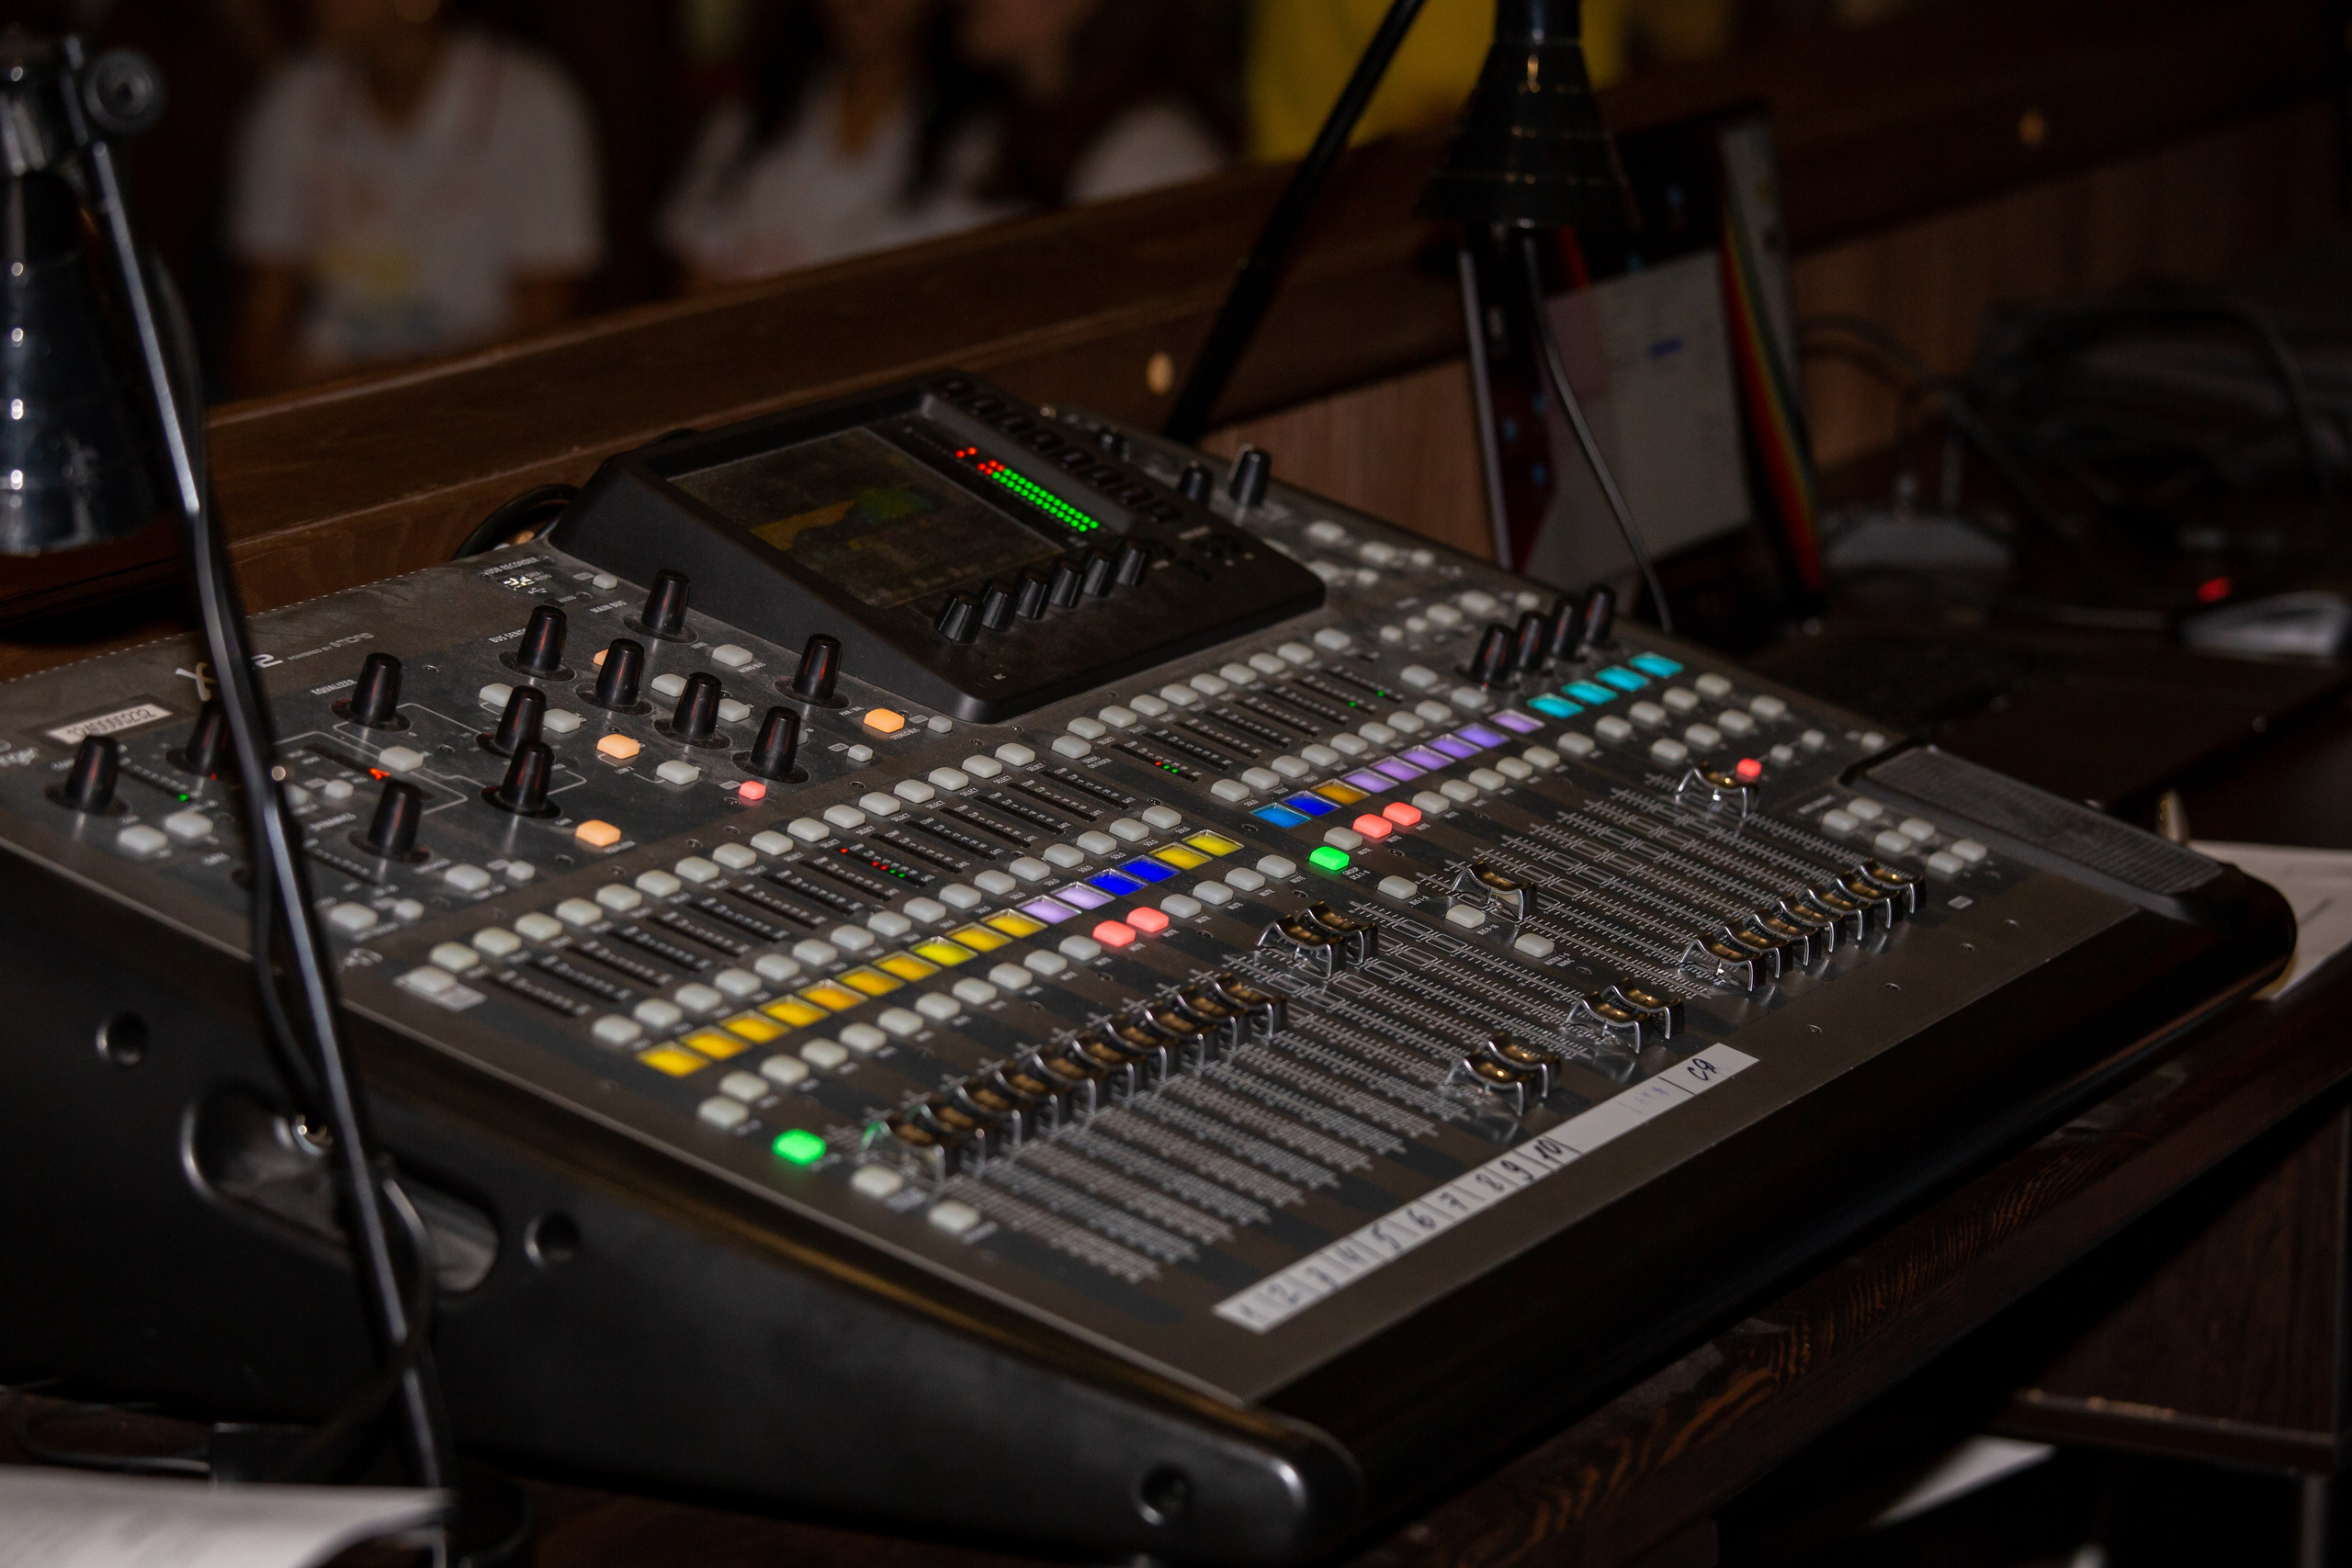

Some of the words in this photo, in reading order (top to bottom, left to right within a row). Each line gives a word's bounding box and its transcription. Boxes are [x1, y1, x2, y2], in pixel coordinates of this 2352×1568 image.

[590, 604, 613, 614] MAIN
[610, 600, 628, 608] BUS
[488, 635, 507, 644] BUS
[311, 679, 358, 695] EQUALIZER
[889, 730, 910, 740] STEREO
[1026, 762, 1046, 772] SELECT
[993, 775, 1012, 784] SELECT
[960, 787, 979, 797] SELECT
[1273, 786, 1289, 795] SOLO
[925, 800, 945, 809] SELECT
[1243, 798, 1259, 807] SOLO
[891, 813, 910, 822] SELECT
[855, 826, 876, 836] SELECT
[1175, 826, 1191, 835] SOLO
[1143, 839, 1159, 847] SOLO
[1357, 847, 1373, 855] MUTE
[1078, 865, 1093, 874] SOLO
[1342, 866, 1360, 876] GROUP
[1044, 878, 1060, 887] SOLO
[1290, 875, 1306, 884] MUTE
[1010, 891, 1026, 900] SOLO
[1258, 888, 1275, 897] MUTE
[1227, 901, 1244, 910] MUTE
[1194, 915, 1212, 924] MUTE
[1162, 929, 1180, 937] MUTE
[1268, 1282, 1301, 1304] 2
[1372, 1222, 1402, 1250] 5
[1407, 1207, 1437, 1229] 6
[1440, 1192, 1469, 1212] 7
[1475, 1173, 1505, 1192] 8
[1500, 1159, 1534, 1181] 9
[1534, 1138, 1566, 1164] 10
